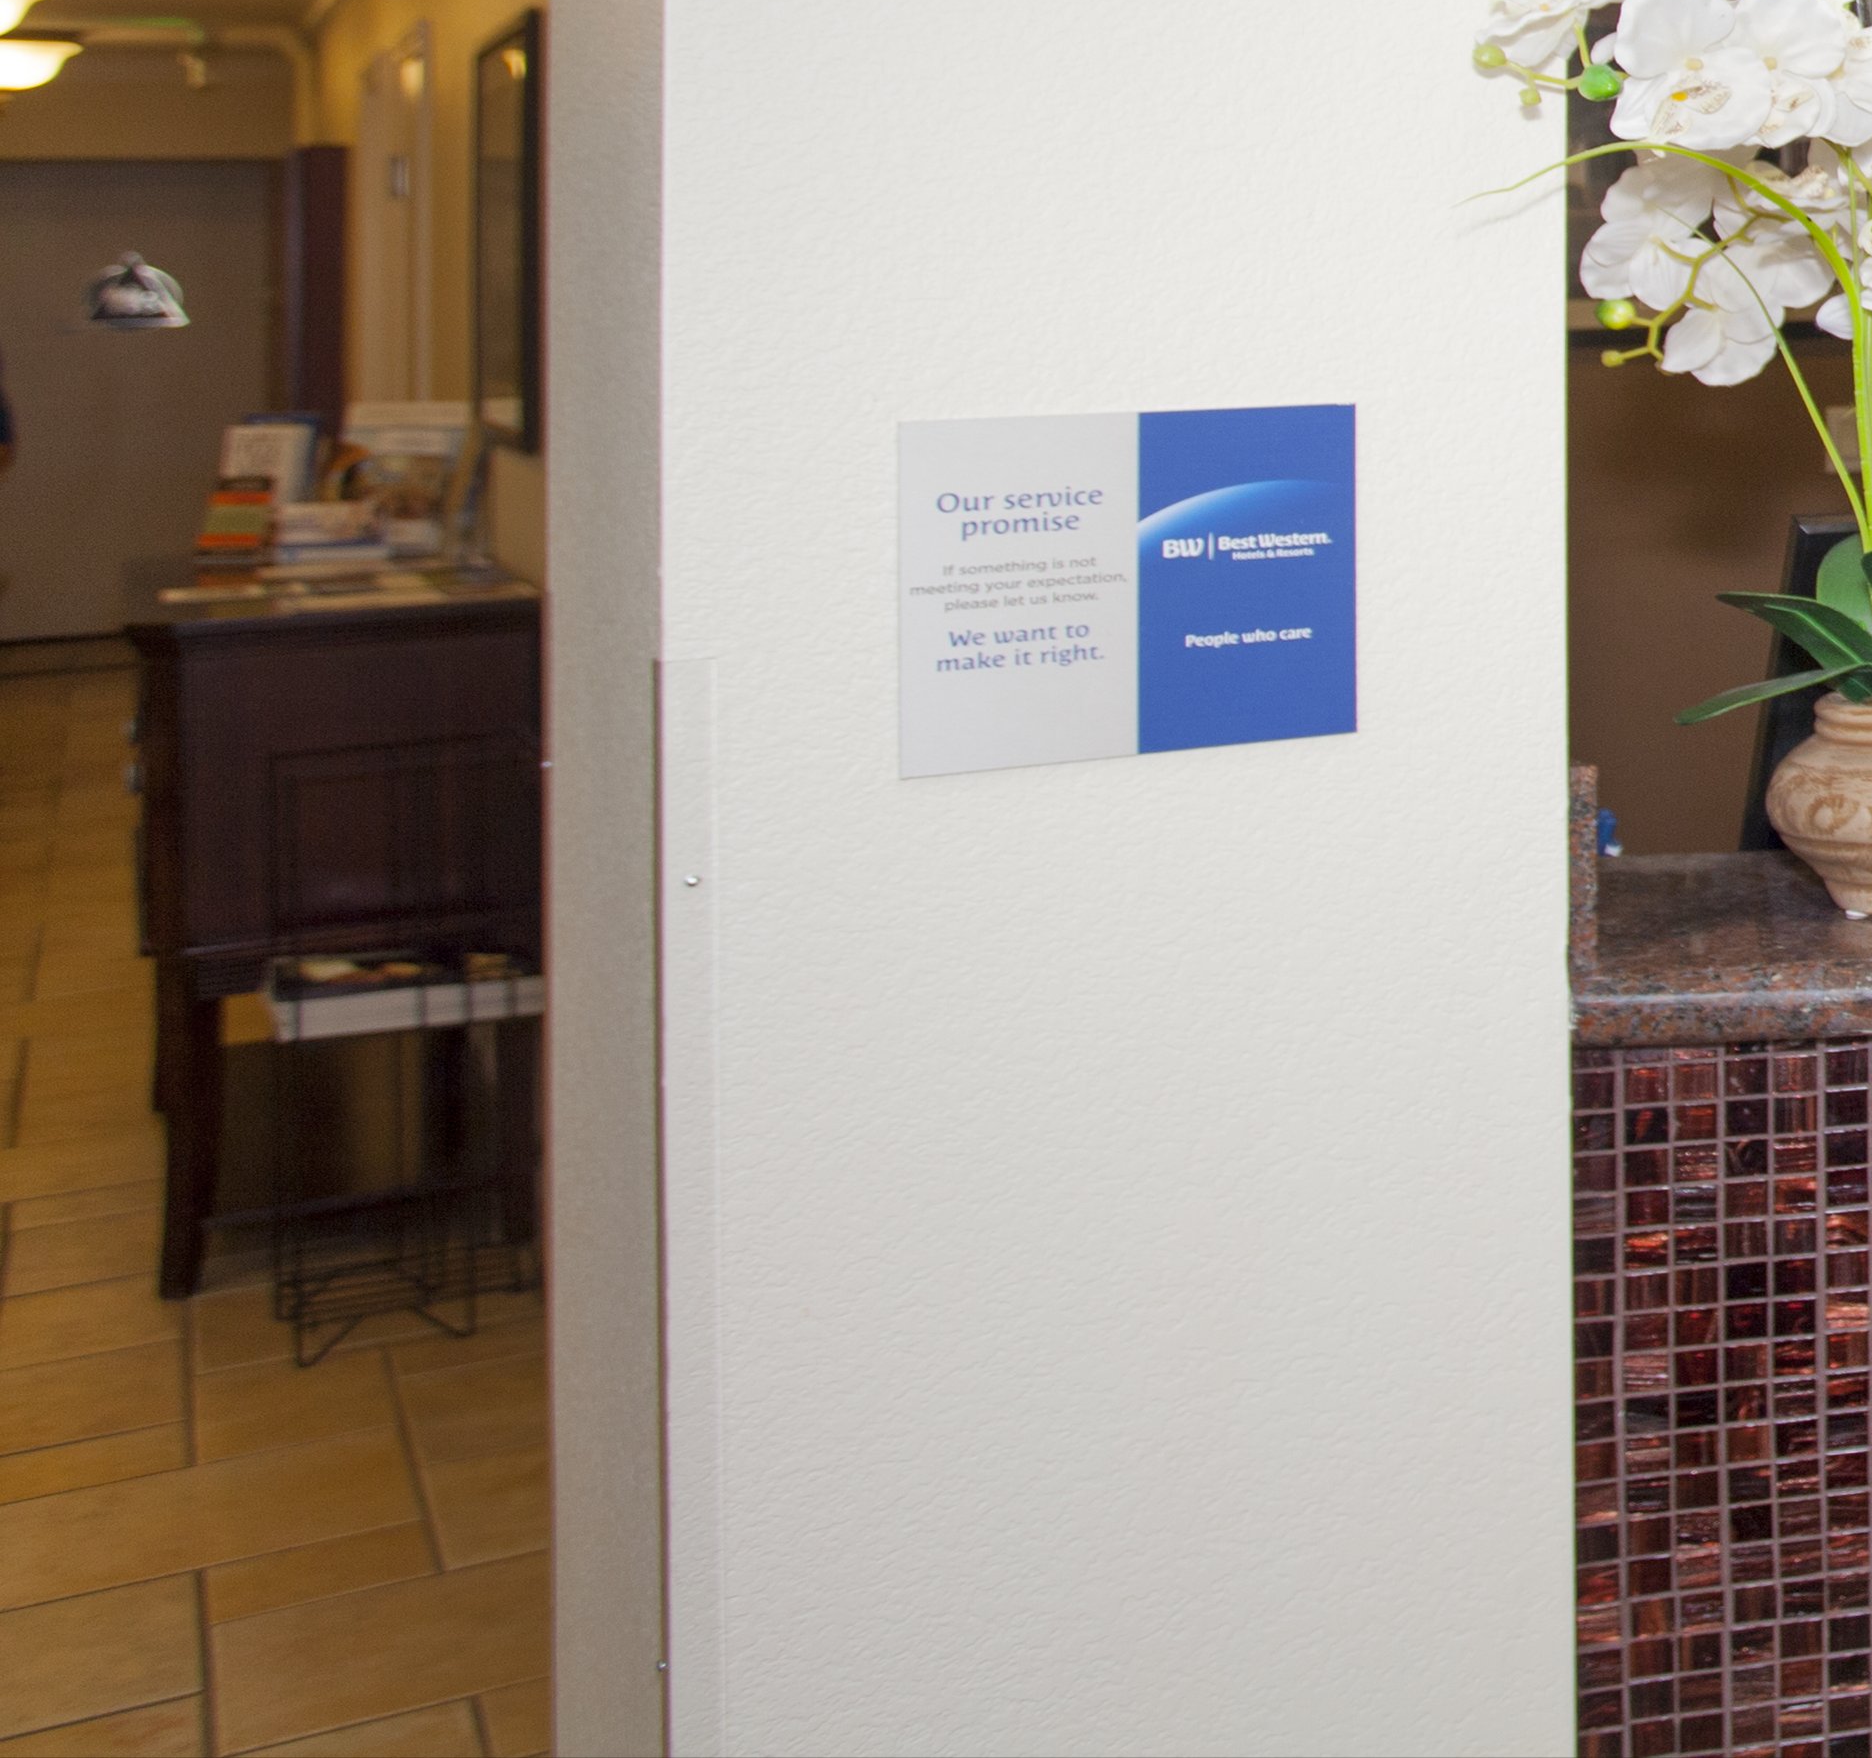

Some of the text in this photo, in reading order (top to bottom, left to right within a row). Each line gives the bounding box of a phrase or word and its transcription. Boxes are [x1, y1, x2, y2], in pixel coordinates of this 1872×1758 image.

[936, 486, 1104, 513] Our service
[961, 511, 1081, 541] promise
[1162, 538, 1205, 559] BW
[1217, 535, 1257, 551] Best
[1232, 550, 1265, 561] Hotels
[1275, 547, 1315, 557] Resorts
[942, 555, 1097, 577] If something is not
[909, 580, 980, 597] meeting
[984, 579, 1021, 594] your
[944, 596, 999, 613] please
[1003, 593, 1025, 608] let
[1029, 593, 1047, 606] us
[948, 624, 1090, 647] We want to
[1184, 627, 1313, 648] People who care
[936, 644, 1104, 672] make it right.
